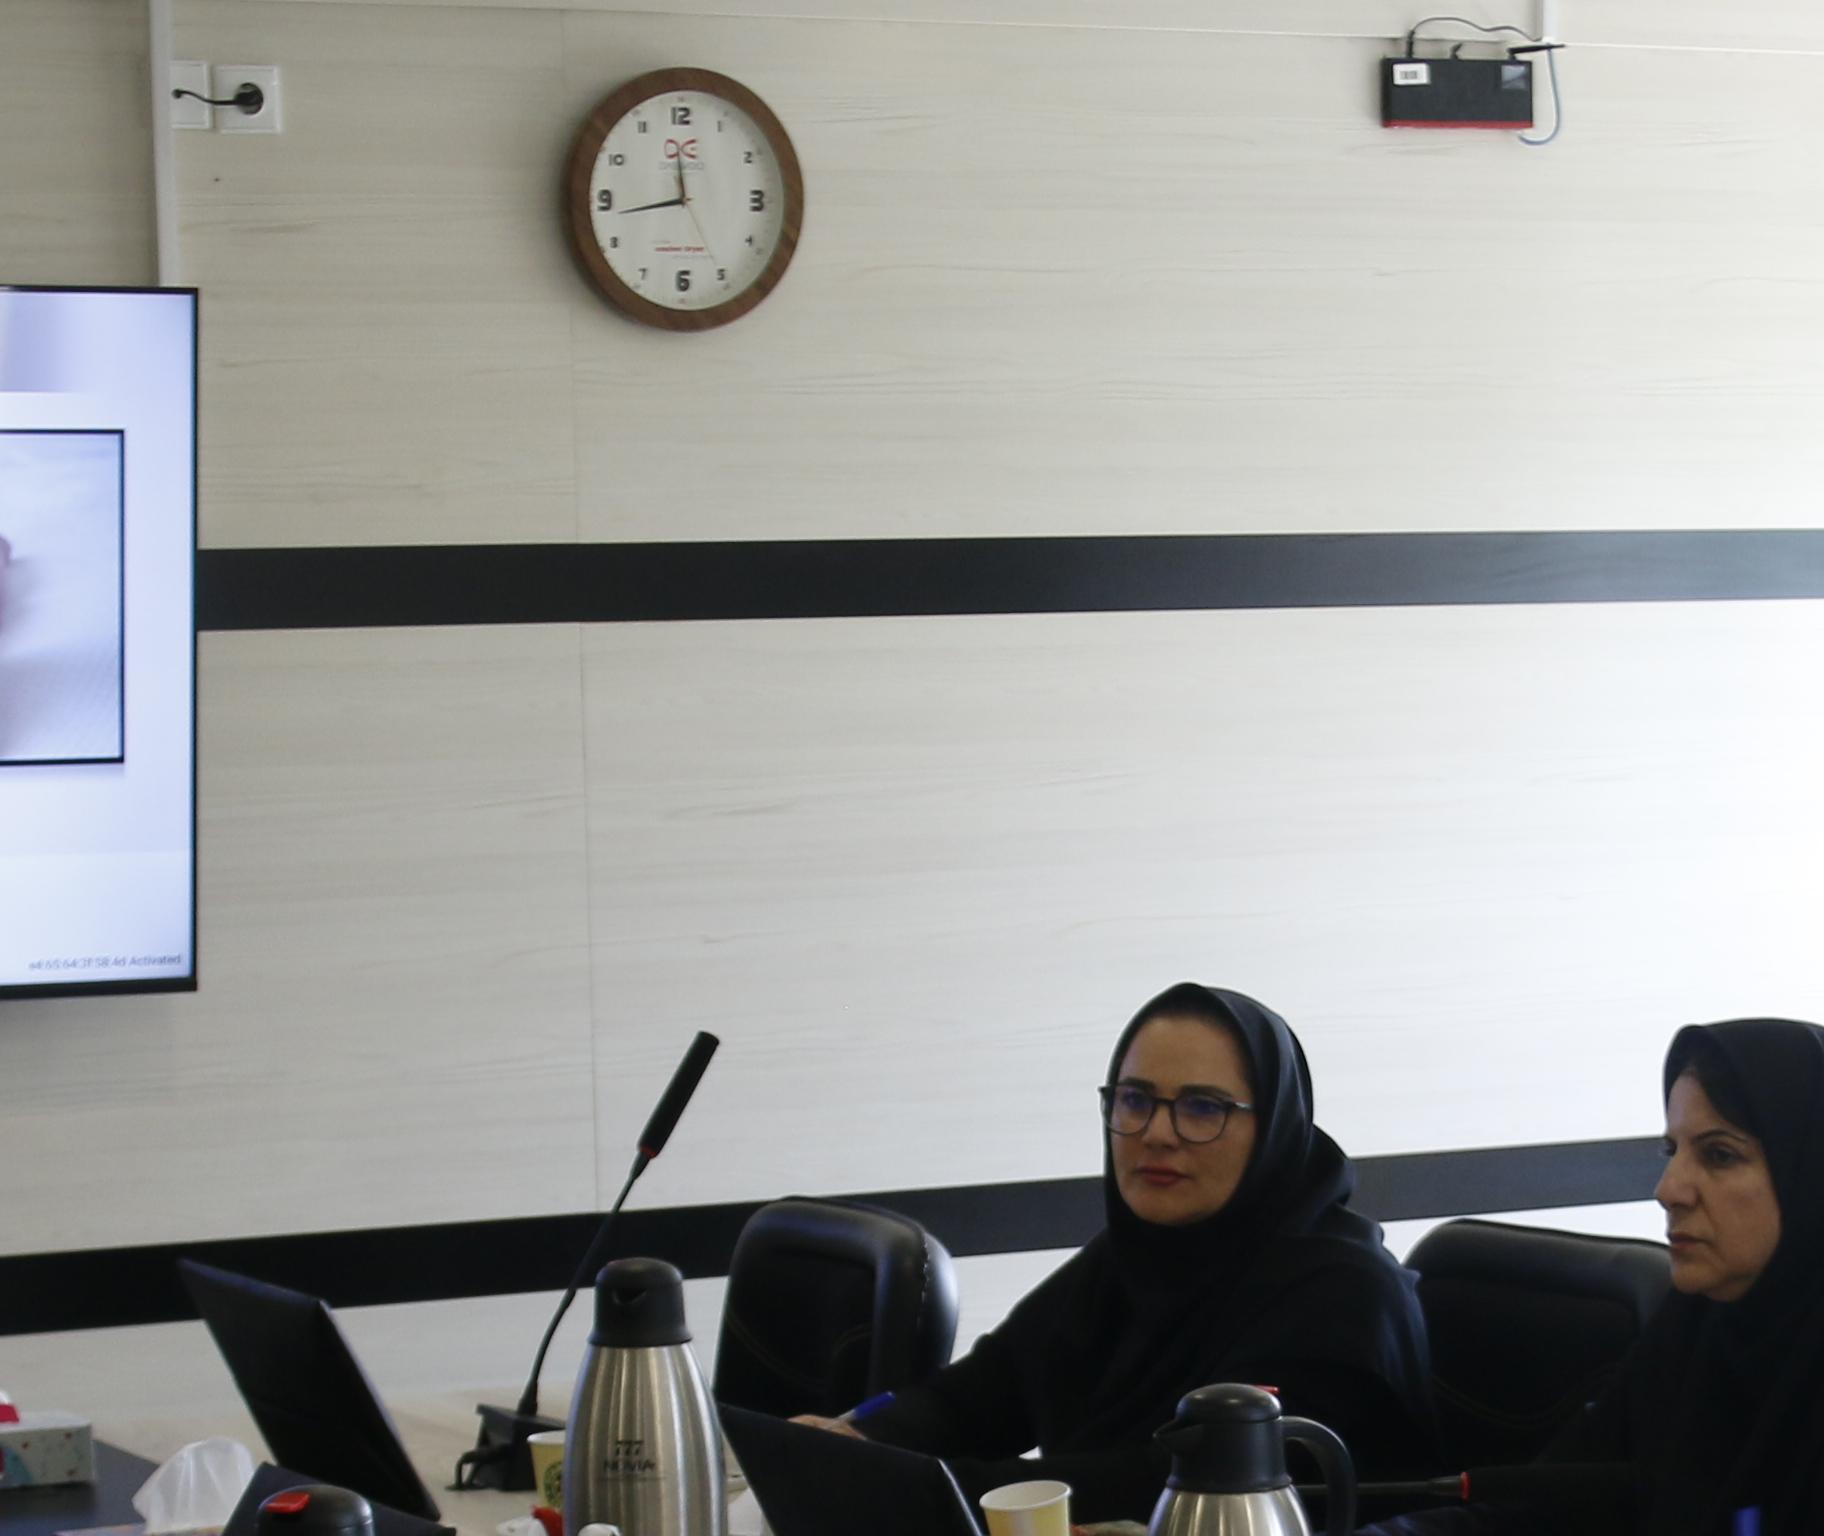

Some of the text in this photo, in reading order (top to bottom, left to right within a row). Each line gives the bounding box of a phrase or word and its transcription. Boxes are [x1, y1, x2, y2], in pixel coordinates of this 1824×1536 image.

[671, 107, 691, 125] 12
[637, 121, 647, 134] 11
[716, 120, 723, 132] 1
[609, 153, 625, 166] 10
[743, 151, 753, 164] 2
[597, 189, 613, 211] 9
[749, 190, 765, 212] 3
[609, 237, 619, 249] 8
[744, 235, 753, 247] 4
[638, 268, 647, 280] 7
[716, 268, 726, 281] 5
[676, 270, 691, 292] 6
[129, 953, 181, 967] Activated
